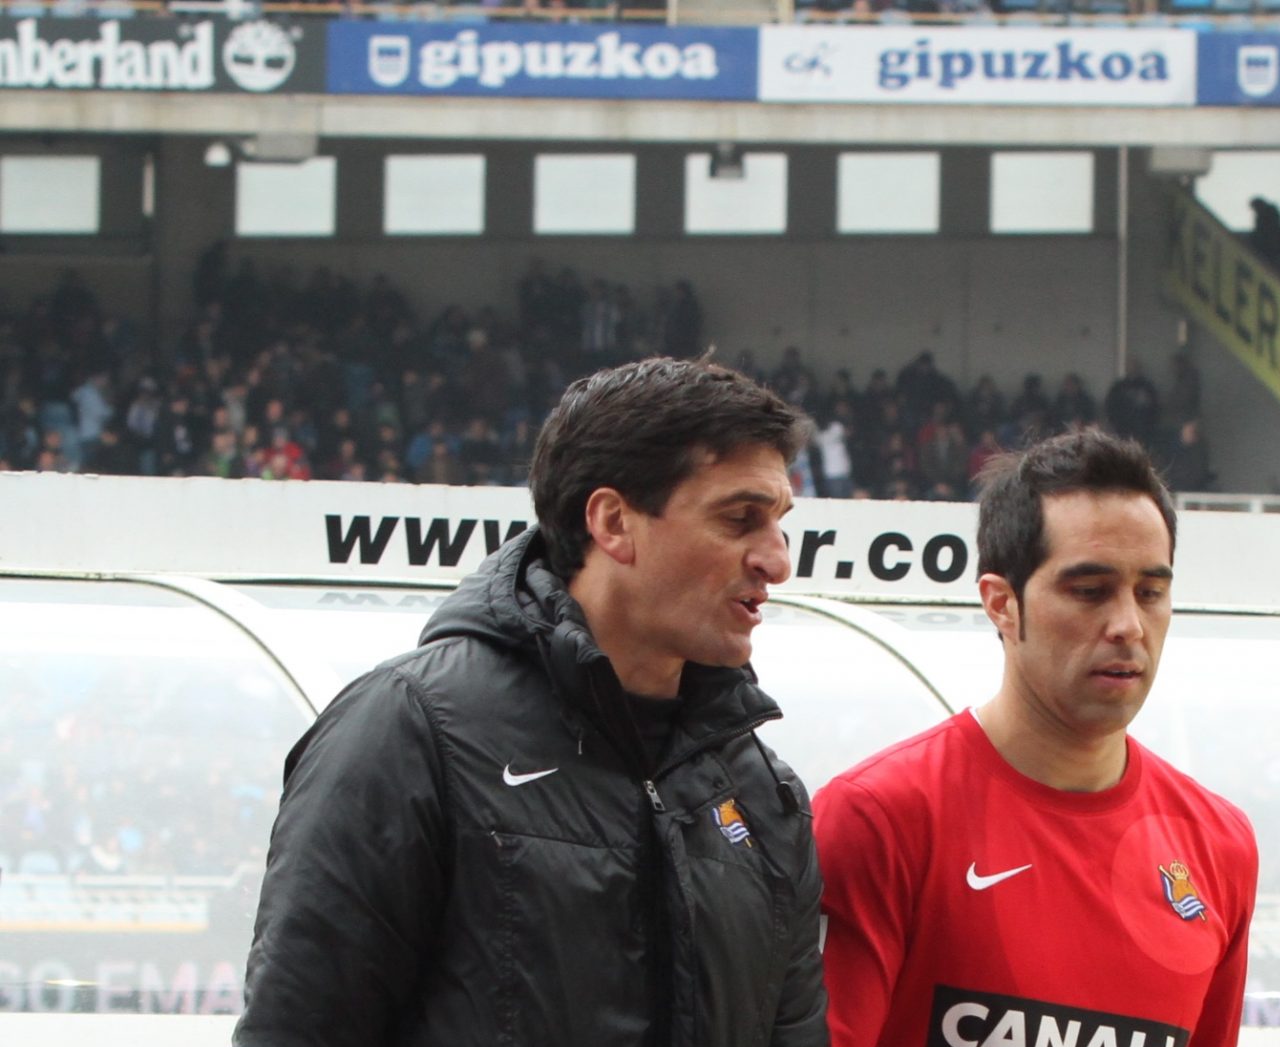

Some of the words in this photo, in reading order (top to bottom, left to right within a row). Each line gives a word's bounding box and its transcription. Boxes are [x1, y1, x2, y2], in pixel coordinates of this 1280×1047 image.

[419, 31, 718, 87] gipuzkoa
[877, 38, 1171, 88] gipuzkoa
[783, 529, 978, 583] r.co
